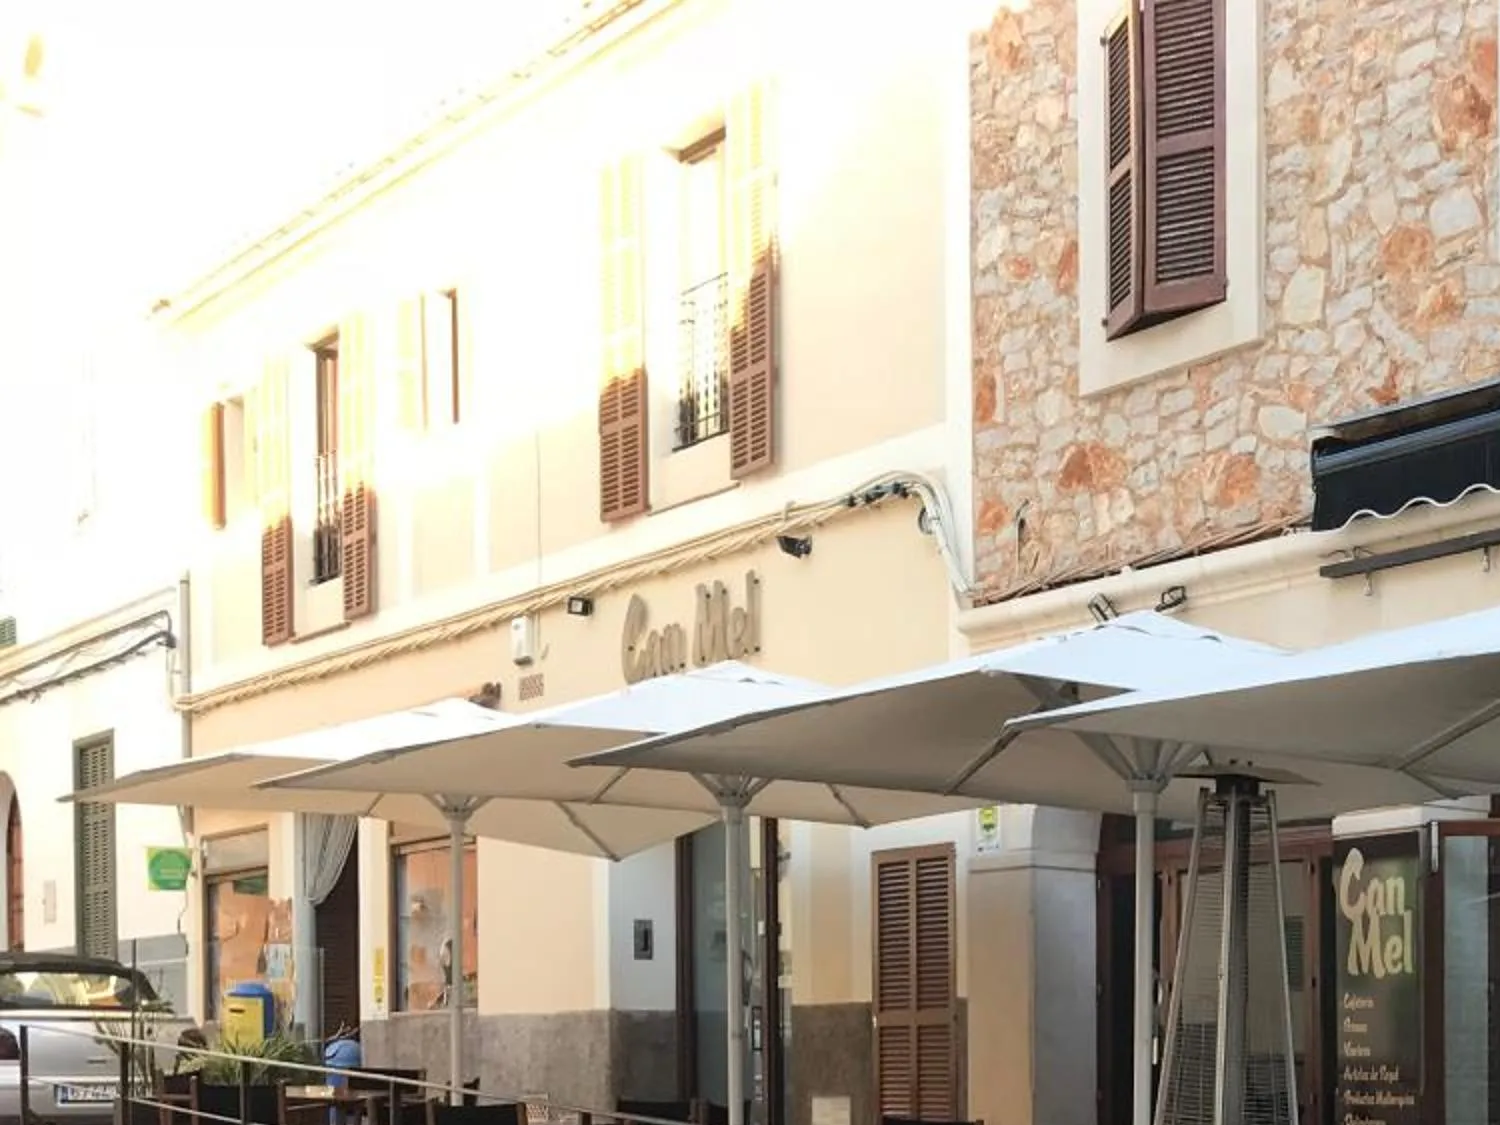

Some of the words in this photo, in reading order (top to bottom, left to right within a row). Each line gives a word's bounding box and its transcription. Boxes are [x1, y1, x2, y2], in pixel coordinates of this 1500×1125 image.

[692, 569, 762, 668] Mel
[1339, 847, 1405, 921] Can
[1347, 909, 1413, 979] Mel
